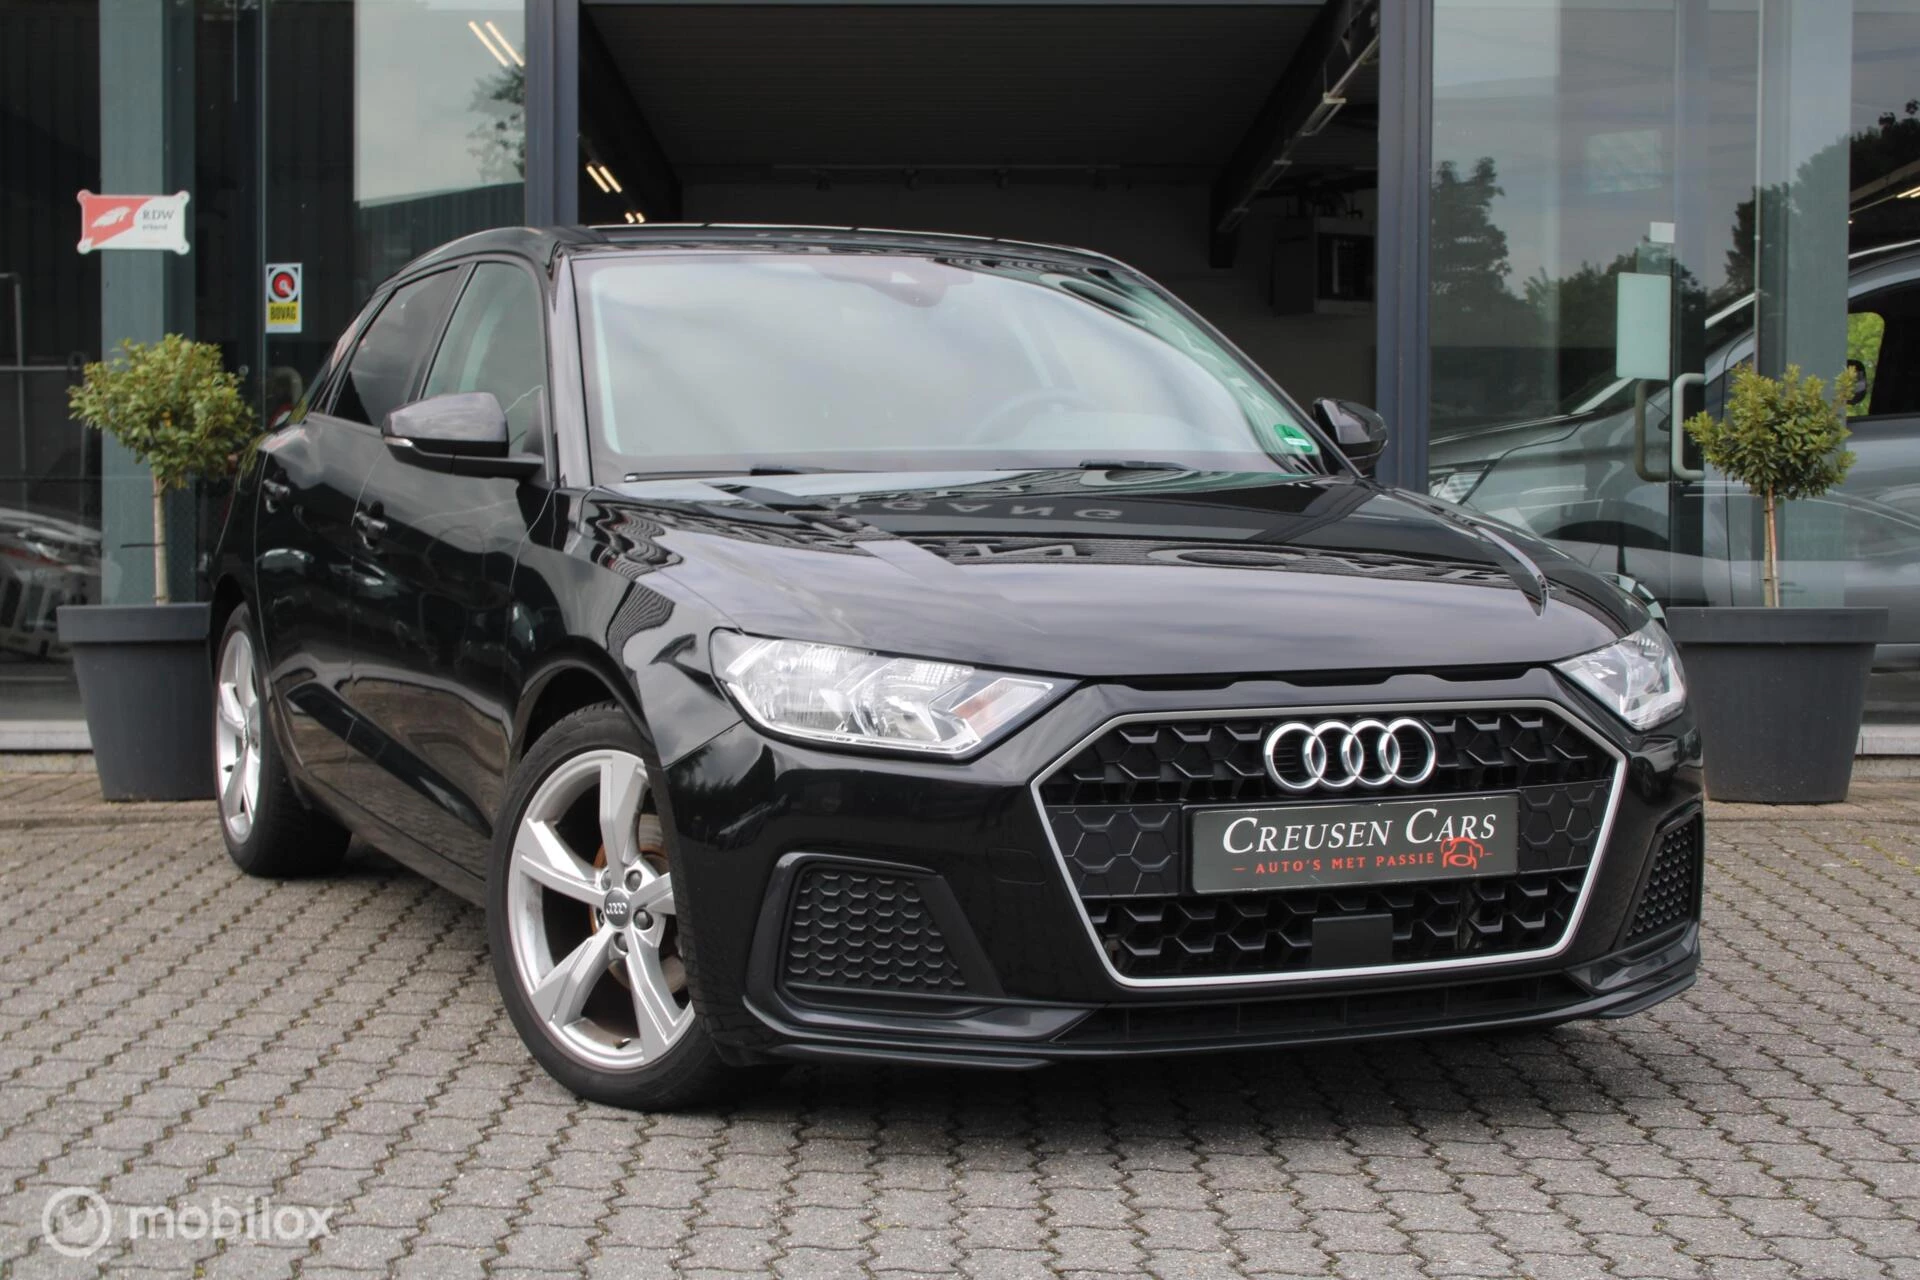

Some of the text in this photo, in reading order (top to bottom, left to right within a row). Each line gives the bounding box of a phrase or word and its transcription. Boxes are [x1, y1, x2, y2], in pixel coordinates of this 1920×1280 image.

[143, 209, 175, 220] RDW
[270, 306, 297, 321] BOVAG
[1222, 807, 1497, 854] CREUSEN CARS
[1255, 852, 1435, 874] AUTO'S MET PASSIE
